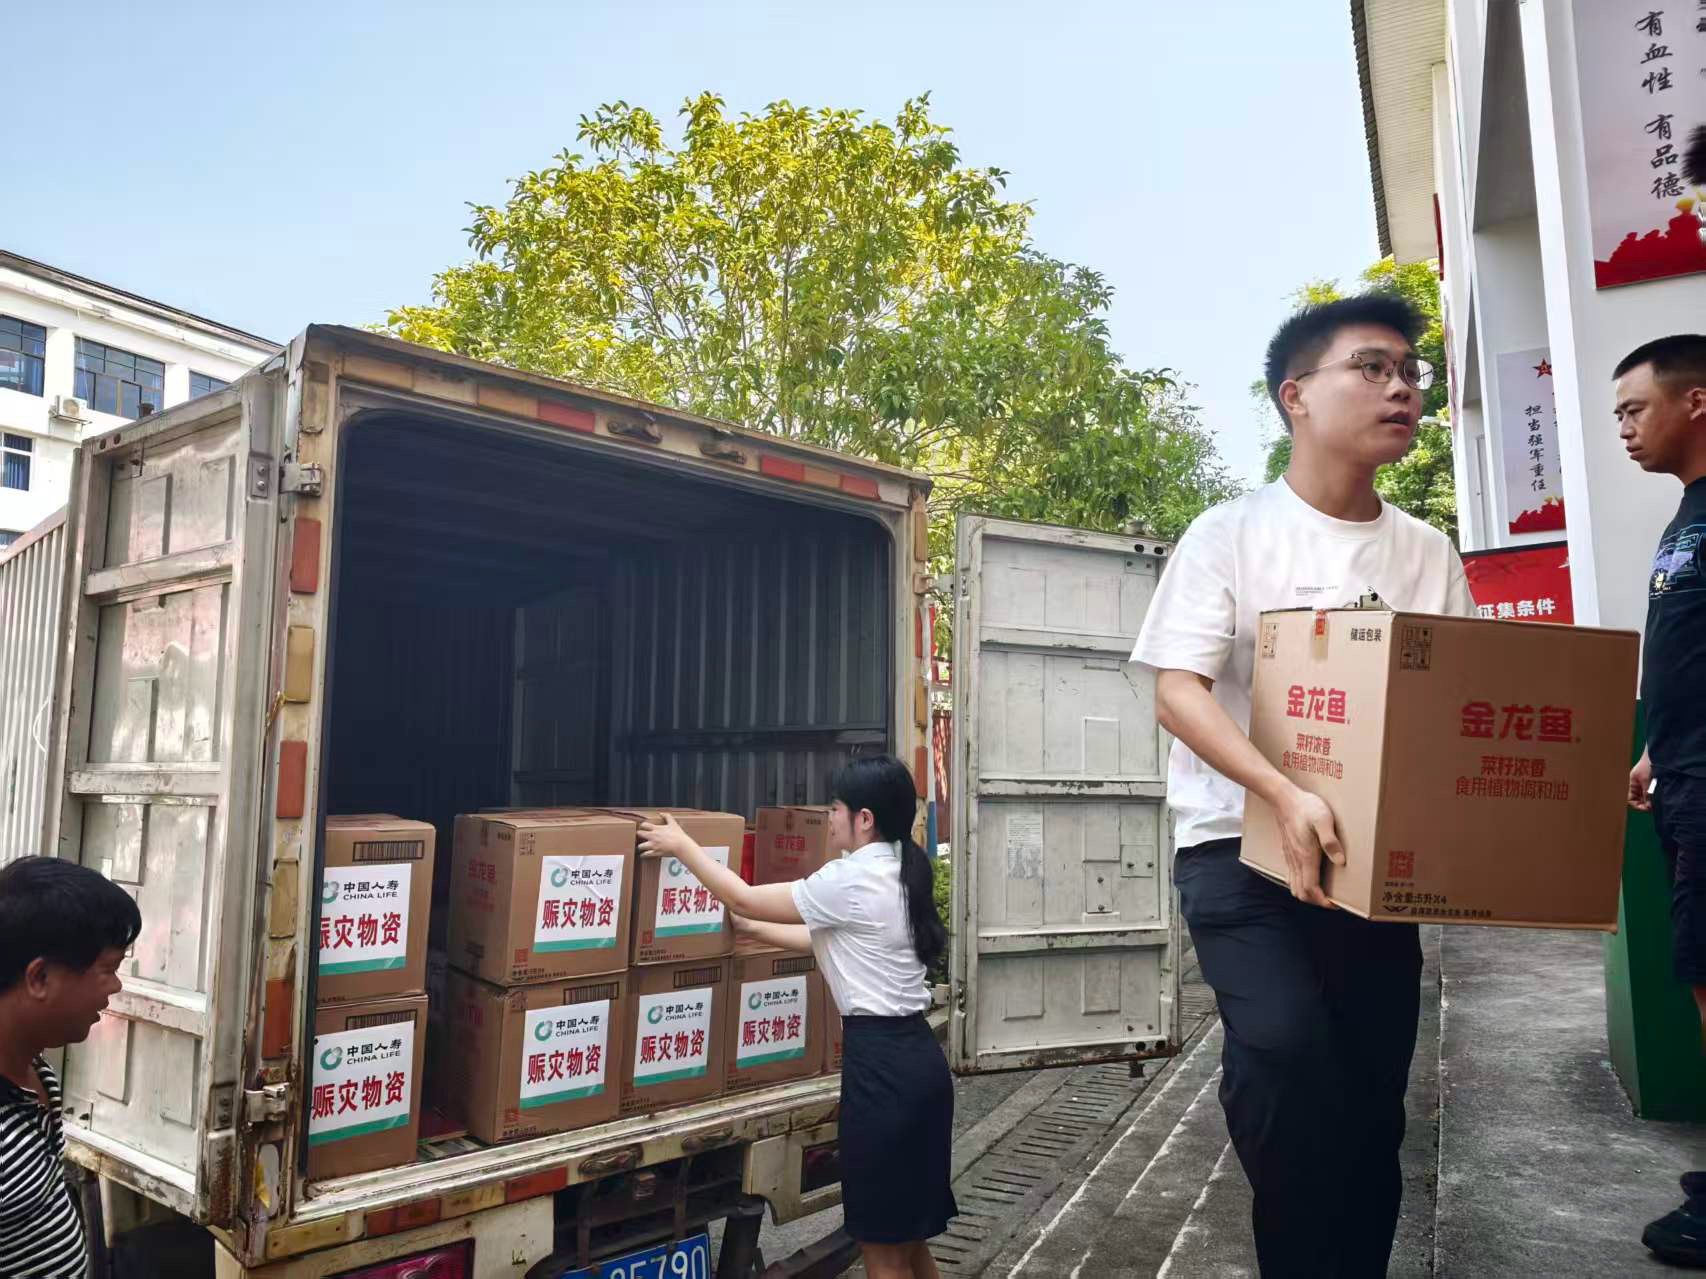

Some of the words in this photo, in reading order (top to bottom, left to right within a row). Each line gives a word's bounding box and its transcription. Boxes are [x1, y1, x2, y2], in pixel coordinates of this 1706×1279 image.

[1635, 10, 1673, 94] 有血性
[1644, 113, 1685, 200] 有品德
[1524, 405, 1547, 492] 担当强军重任
[1350, 627, 1383, 643] 储运包装
[1286, 684, 1347, 725] 金龙鱼
[1460, 701, 1573, 743] 金龙鱼
[1480, 755, 1546, 778] 菜籽浓香
[1455, 775, 1569, 801] 食用植物调和油
[343, 880, 399, 893] 中国人寿
[571, 869, 614, 879] 中国人寿
[343, 893, 375, 901] CHINA
[377, 891, 398, 899] LIFE
[541, 896, 614, 929] 赈灾物资
[556, 1015, 600, 1030] 中国人寿
[665, 1002, 704, 1015] 中国人寿
[582, 1025, 599, 1033] LIFE
[742, 1013, 801, 1048] 赈灾物资
[346, 1038, 402, 1057] 中国人寿
[346, 1054, 378, 1065] CHINA
[380, 1049, 401, 1059] LIFE
[640, 1028, 705, 1065] 赈灾物资
[526, 1043, 601, 1085] 赈灾物资
[311, 1070, 405, 1121] 赈灾物资
[610, 1246, 706, 1279] 790
